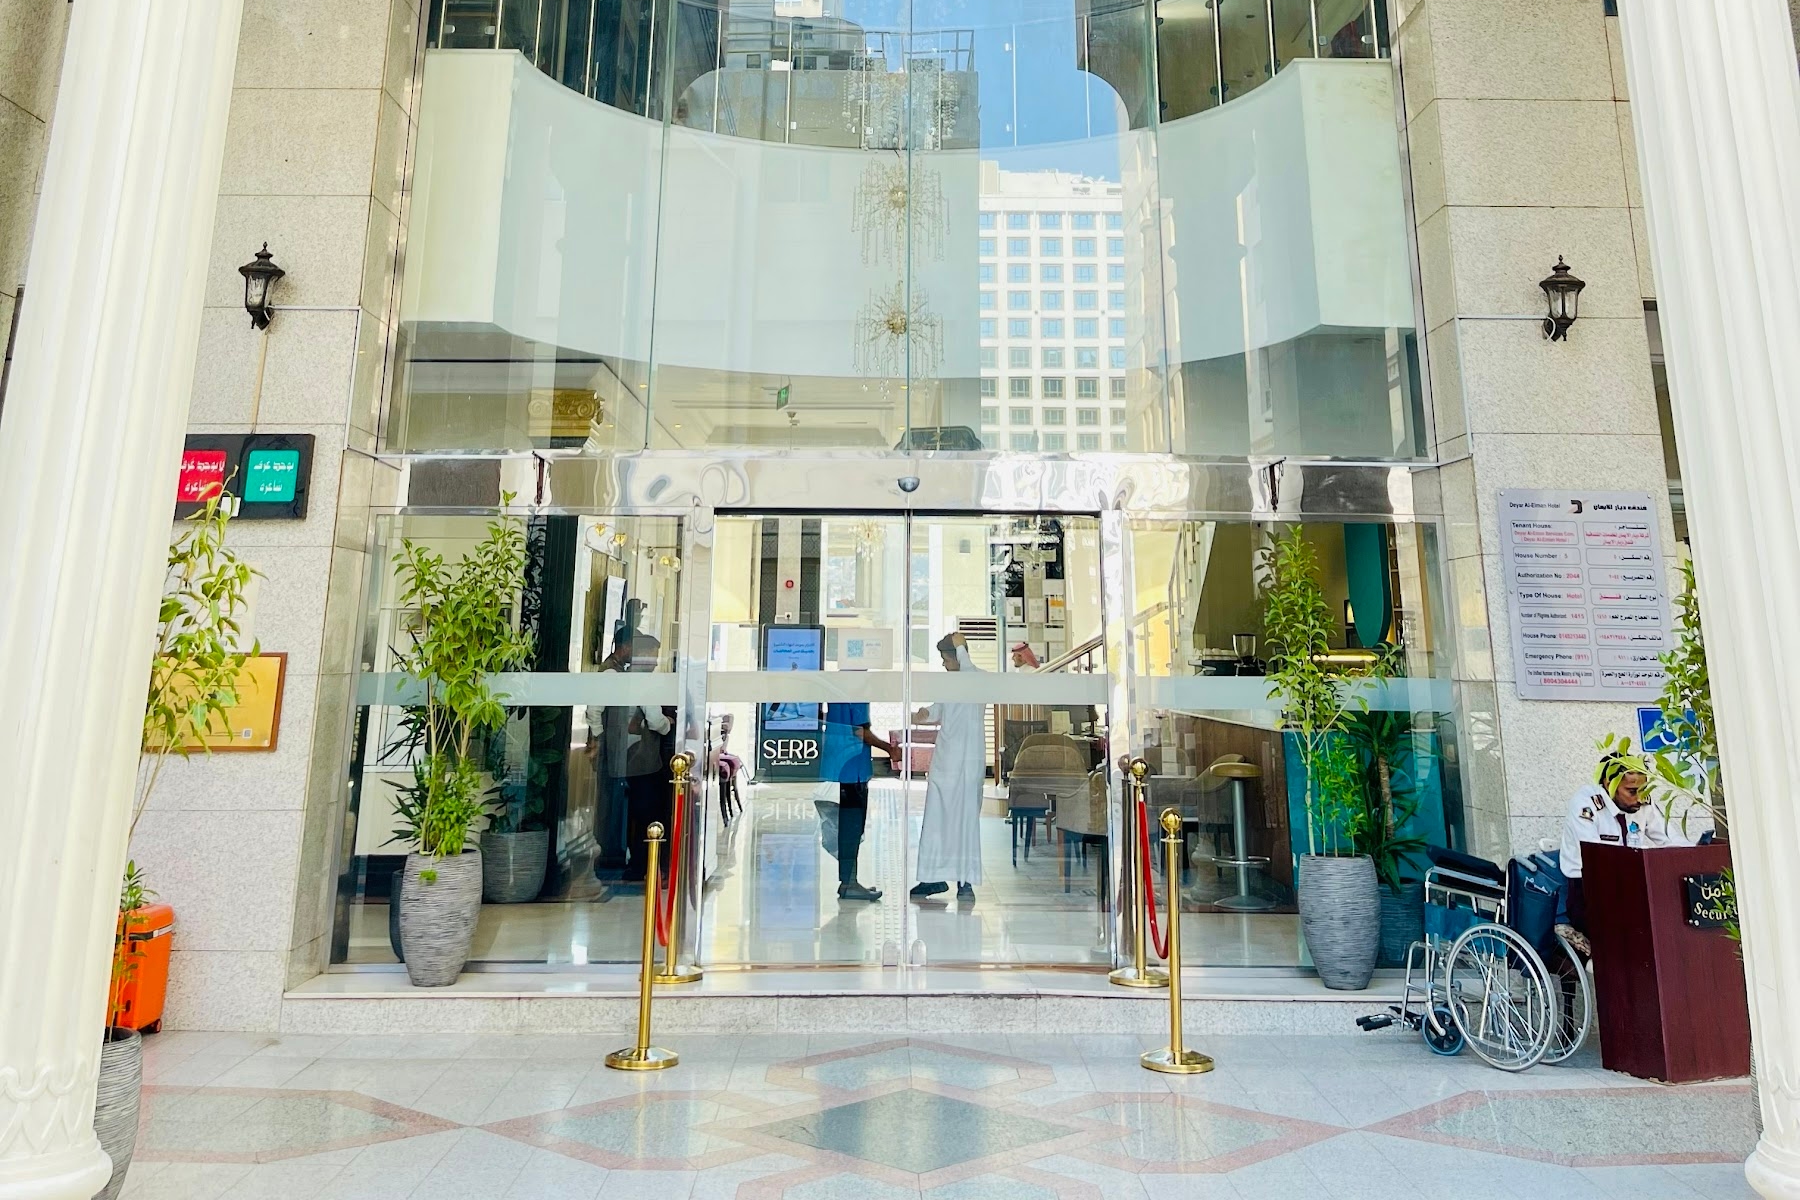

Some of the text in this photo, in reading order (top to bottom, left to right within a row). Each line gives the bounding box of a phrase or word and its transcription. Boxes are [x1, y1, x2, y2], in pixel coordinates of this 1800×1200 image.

[197, 462, 218, 472] يوجد
[254, 460, 294, 473] يوجد غرف
[763, 739, 818, 759] SERB
